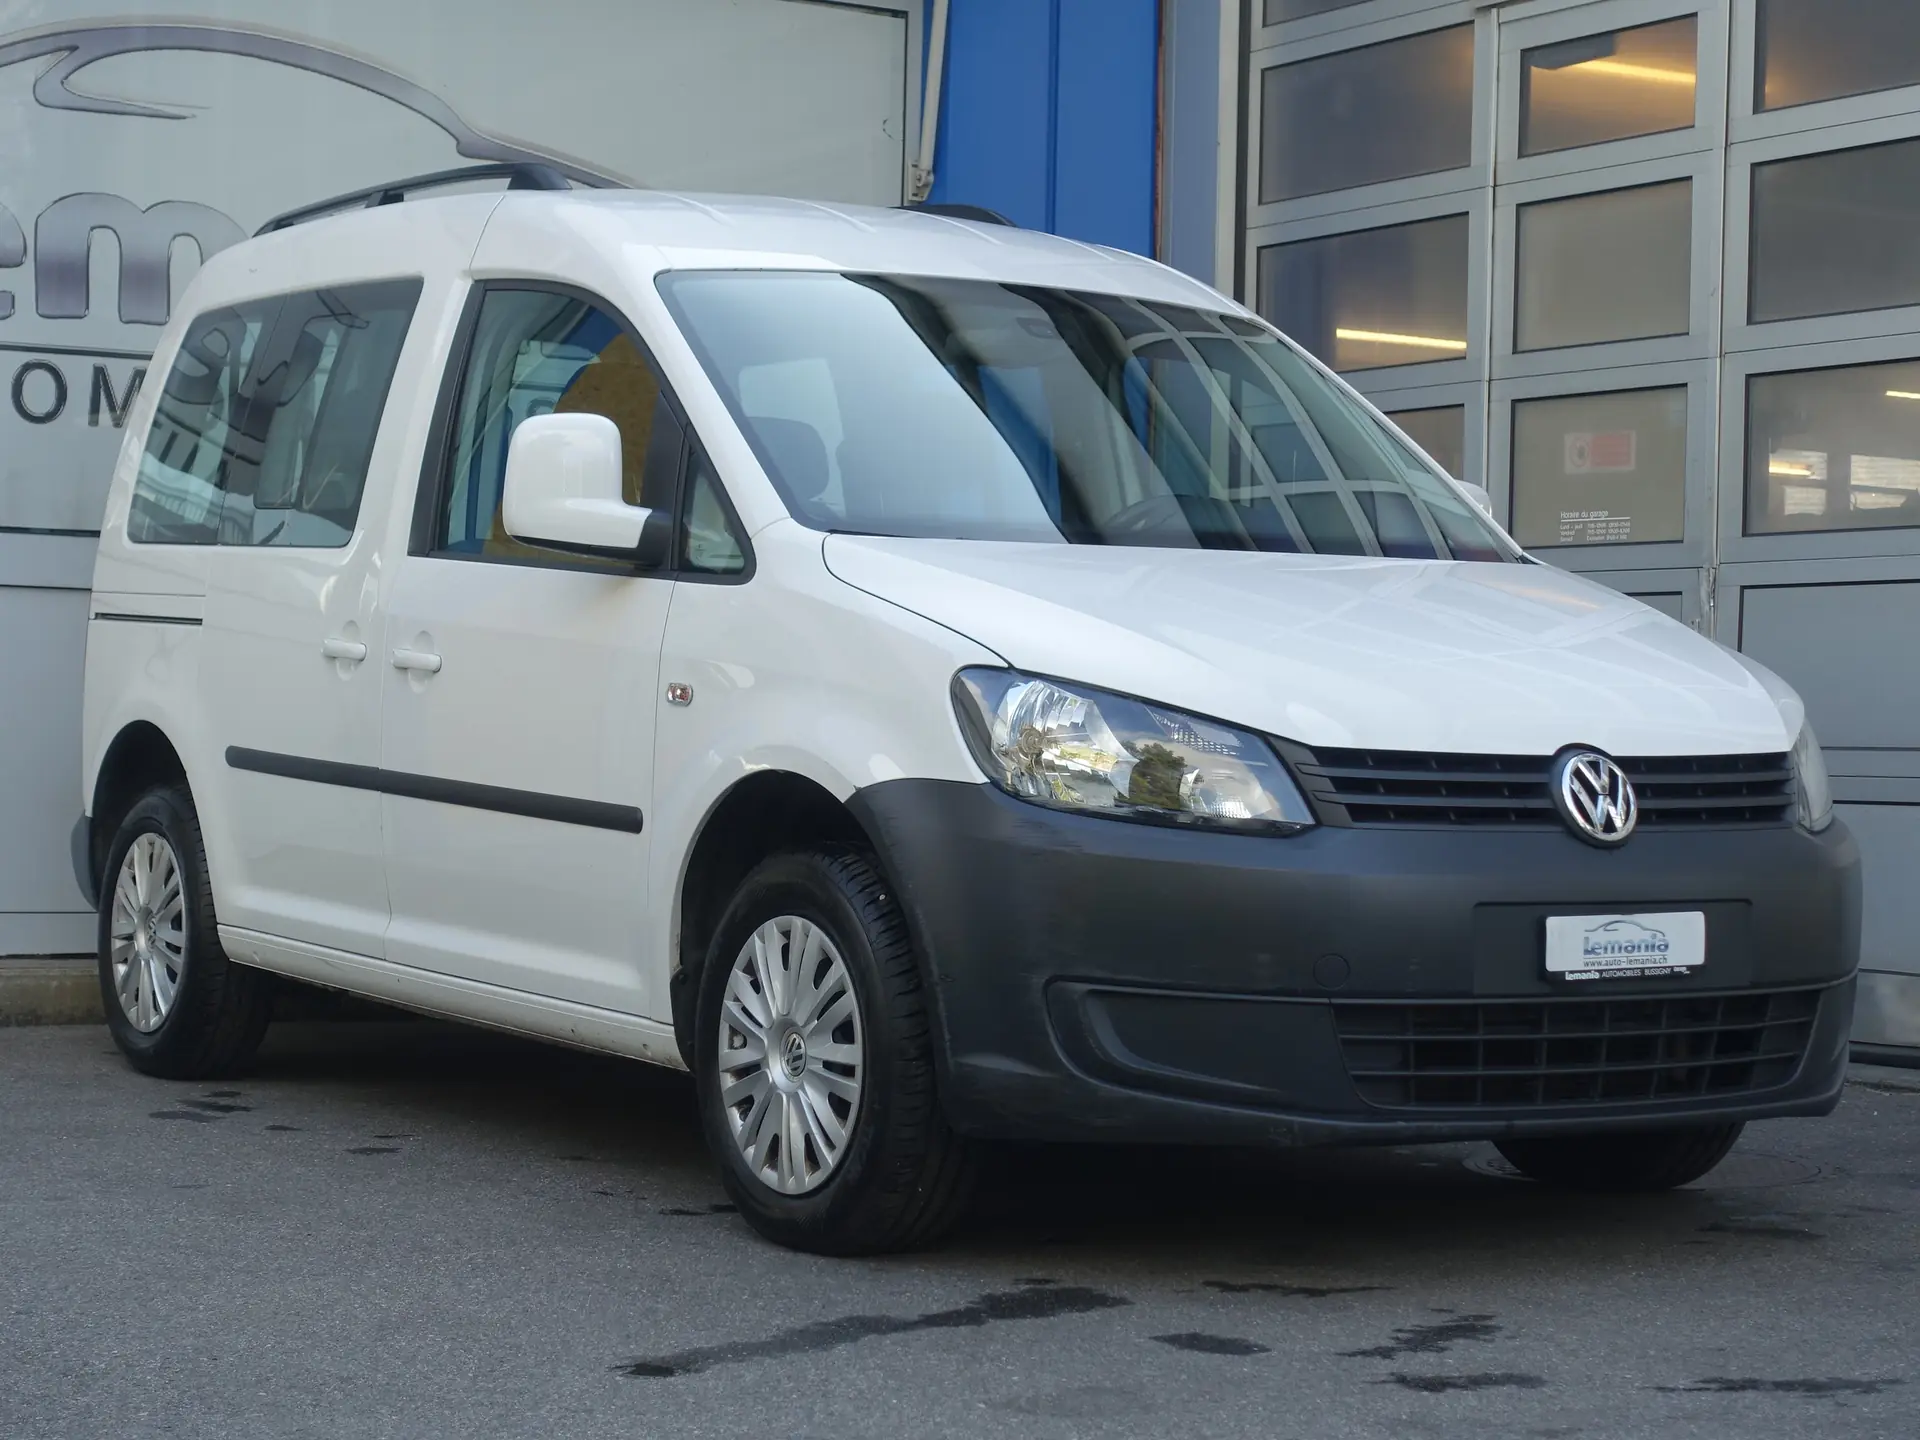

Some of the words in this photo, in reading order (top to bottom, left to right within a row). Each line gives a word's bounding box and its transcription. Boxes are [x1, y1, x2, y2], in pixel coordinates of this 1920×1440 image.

[1581, 510, 1588, 518] du
[1583, 954, 1668, 968] www.auto-lemania.ch
[1601, 969, 1642, 978] AUTOMOBILES
